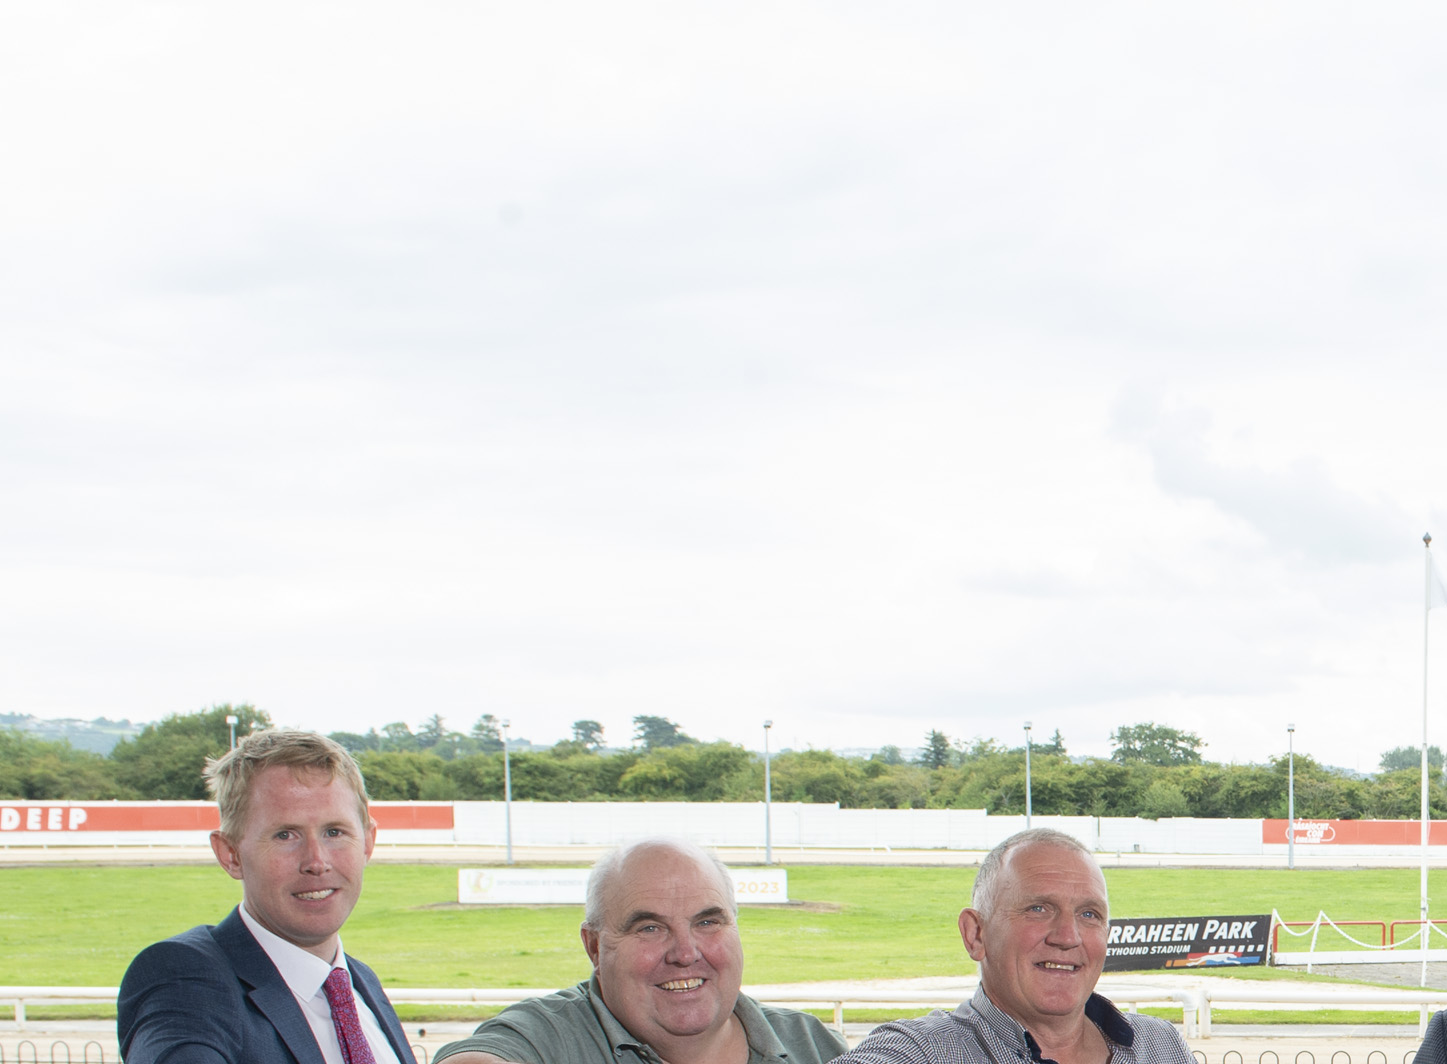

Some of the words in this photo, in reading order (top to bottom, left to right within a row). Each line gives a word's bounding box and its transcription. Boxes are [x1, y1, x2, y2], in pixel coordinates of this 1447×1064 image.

[0, 807, 88, 830] DEEP
[737, 881, 780, 894] 2023
[1107, 923, 1200, 944] RRAHEEN
[1202, 919, 1257, 940] PARK
[1106, 946, 1149, 956] EYHOUND
[1150, 944, 1192, 955] STADIUM
